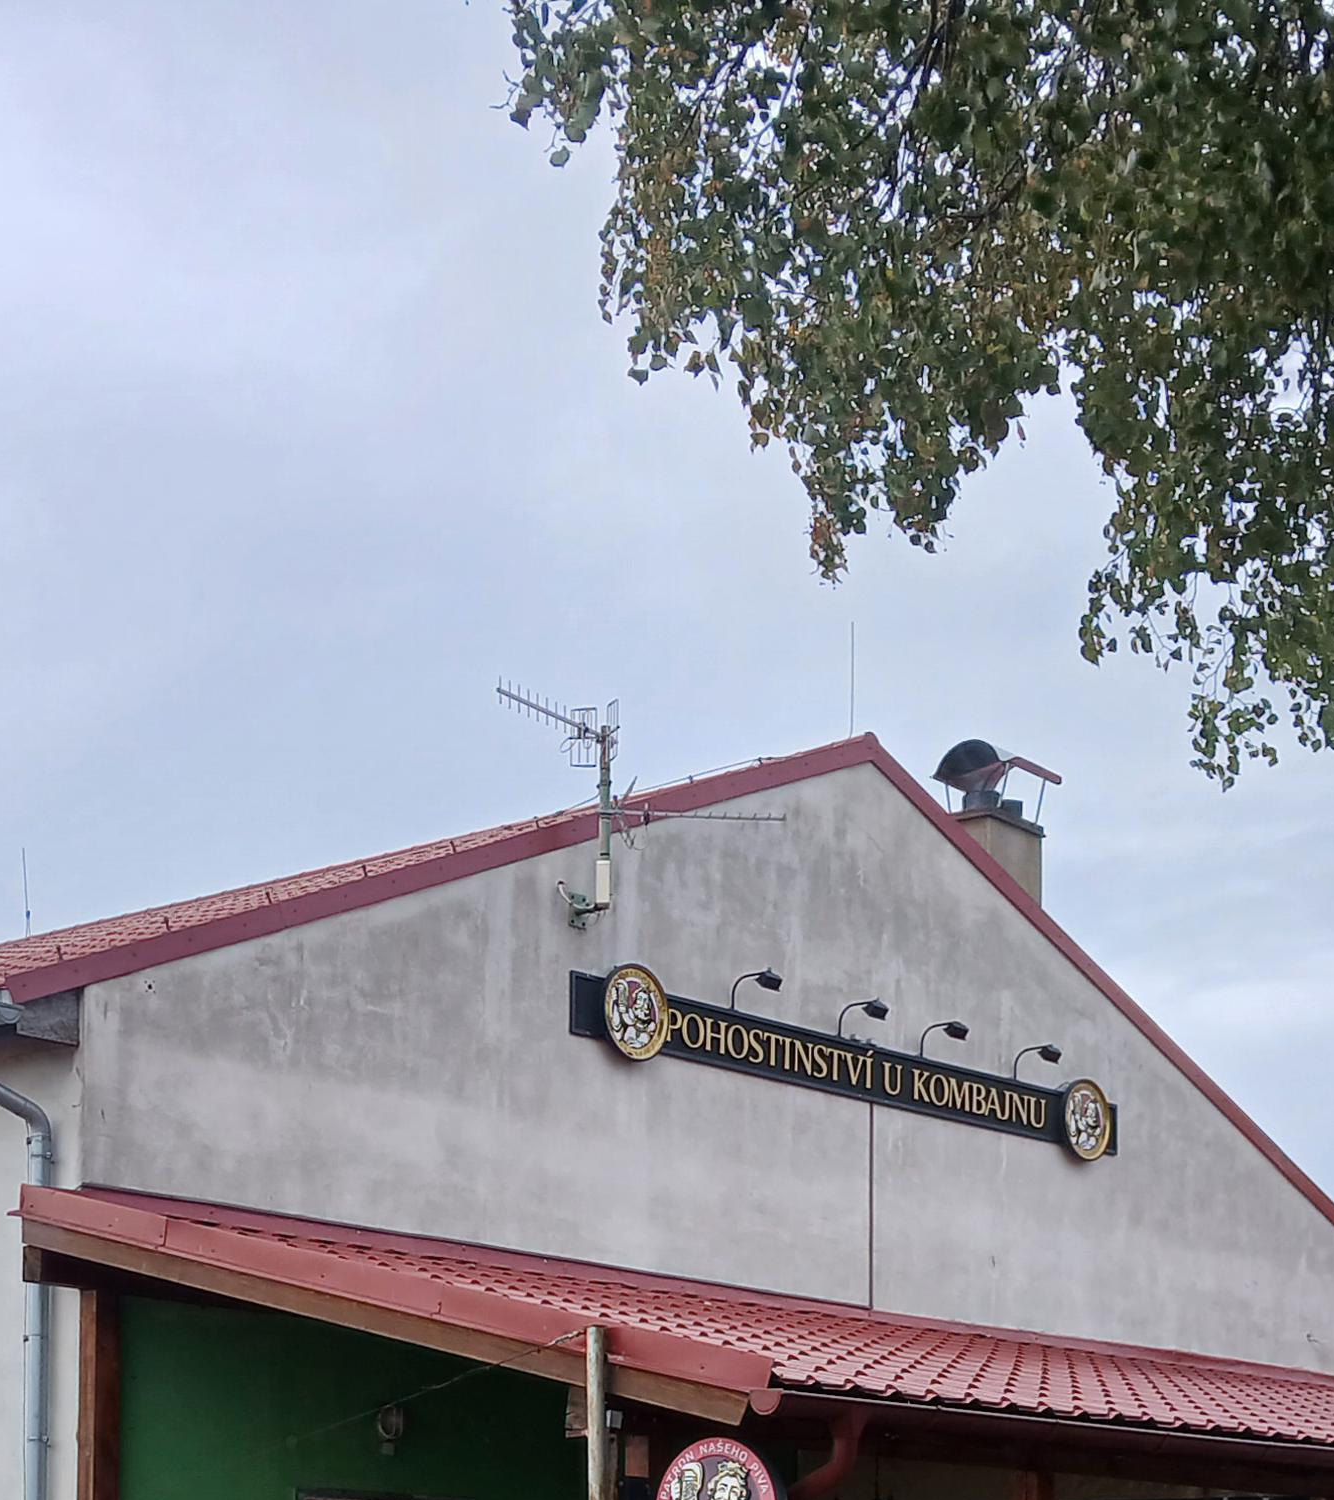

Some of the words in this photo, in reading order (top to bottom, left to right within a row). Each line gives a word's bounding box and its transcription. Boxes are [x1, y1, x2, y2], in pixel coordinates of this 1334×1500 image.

[666, 1008, 875, 1089] POHOSTINSTVÍ
[882, 1061, 904, 1096] U
[911, 1068, 1047, 1128] KOMBAJNU
[659, 1451, 695, 1500] PATRON
[699, 1439, 748, 1462] NAŠEHO
[749, 1463, 769, 1495] PIVA
